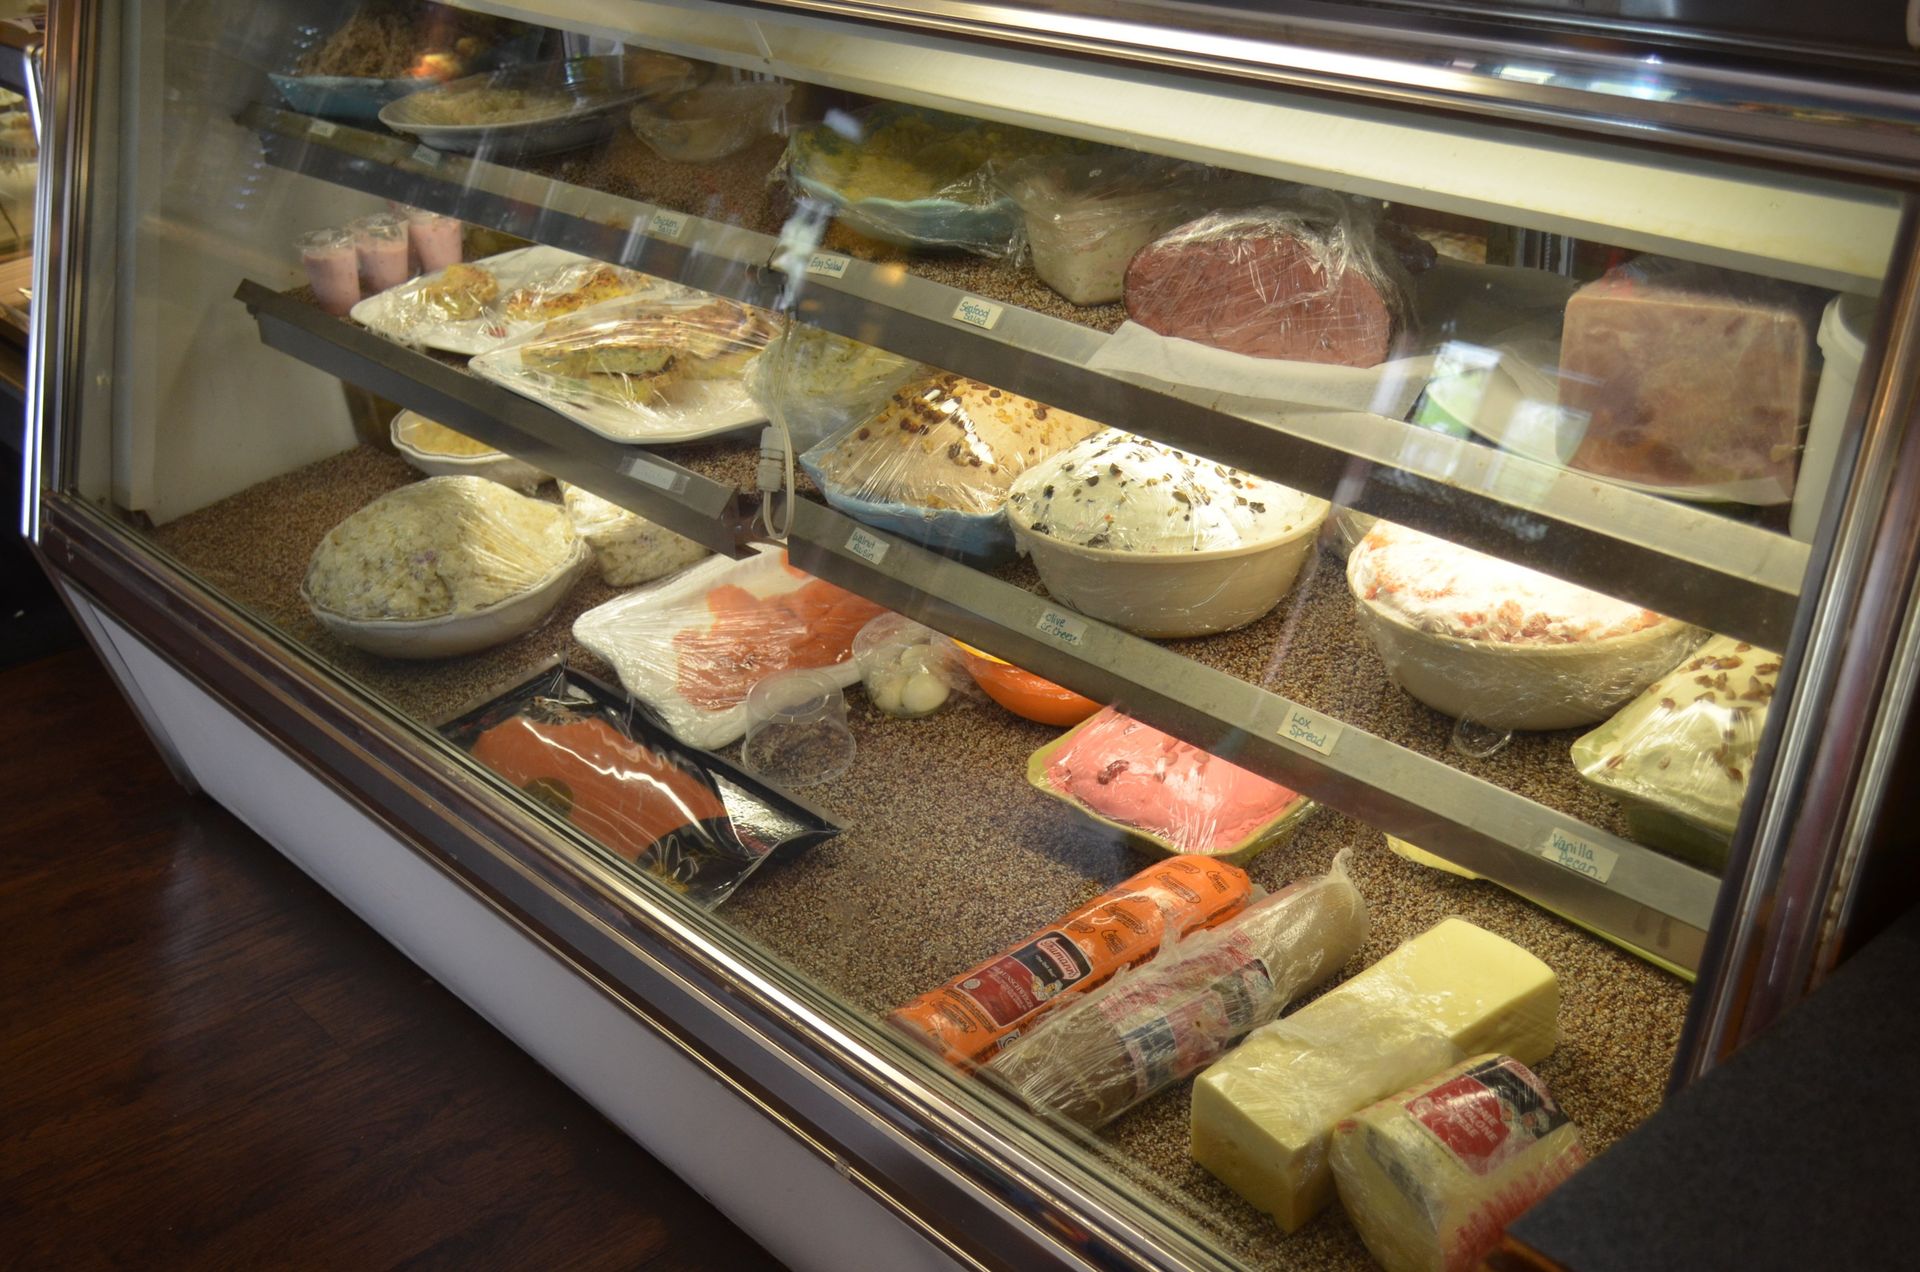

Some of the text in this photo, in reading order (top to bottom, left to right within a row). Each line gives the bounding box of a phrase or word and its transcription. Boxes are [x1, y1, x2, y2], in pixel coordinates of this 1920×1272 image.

[811, 256, 845, 272] Egg Salad
[960, 301, 990, 319] Seafood
[963, 312, 986, 326] Salad
[1292, 712, 1311, 729] Lox
[1289, 724, 1327, 748] Spread
[1553, 833, 1594, 862] Vanilla
